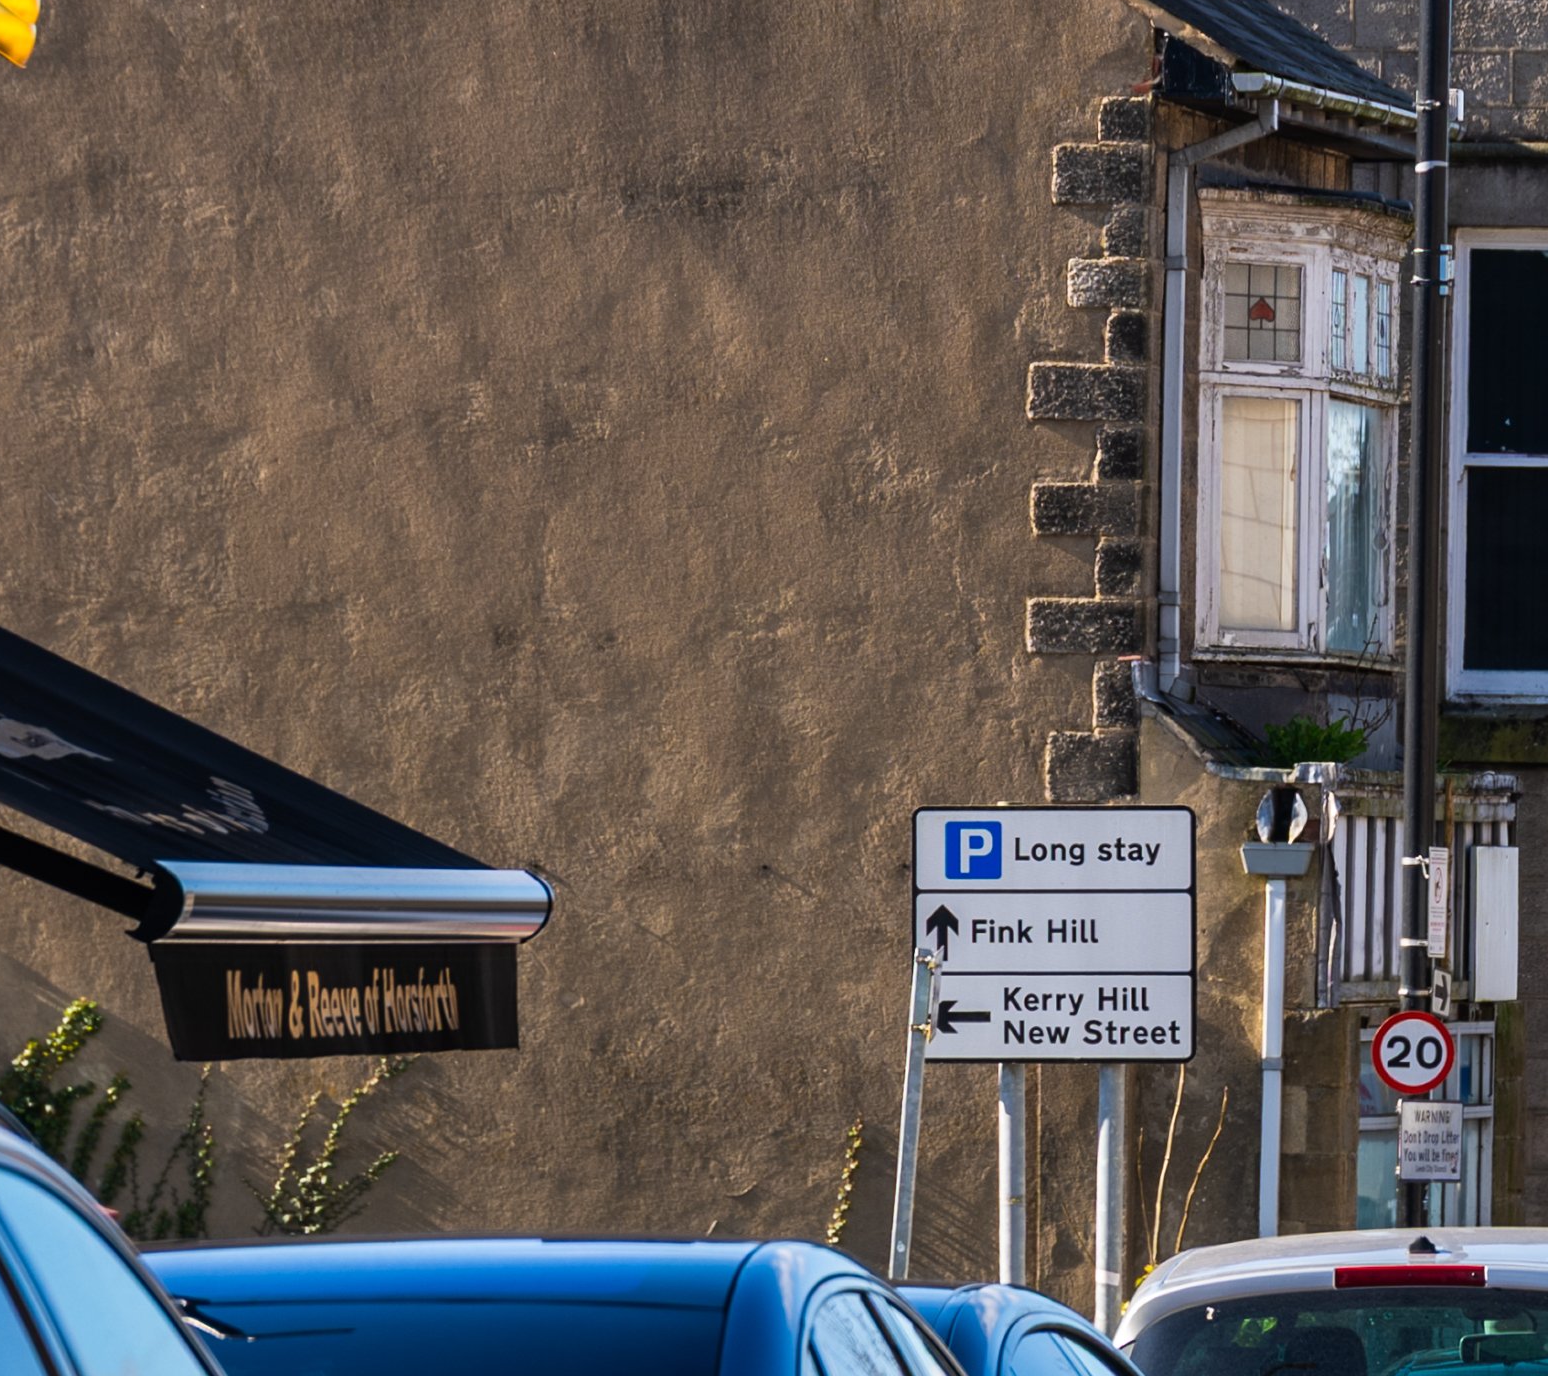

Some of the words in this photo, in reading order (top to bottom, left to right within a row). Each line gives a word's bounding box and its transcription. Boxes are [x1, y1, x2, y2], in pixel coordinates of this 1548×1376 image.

[959, 828, 994, 874] P
[1013, 836, 1086, 868] Long
[1097, 837, 1162, 866] stay
[970, 919, 1033, 945] Fink
[1047, 919, 1099, 944] Hill
[226, 970, 284, 1040] Morton
[288, 970, 304, 1040] &
[307, 970, 362, 1039] Reeve
[364, 967, 380, 1036] of
[382, 966, 459, 1034] Horsforth
[1002, 987, 1084, 1016] Kerry
[1097, 987, 1150, 1012] Hill
[1002, 1021, 1070, 1046] New
[1082, 1020, 1181, 1046] Street
[1386, 1035, 1443, 1069] 20
